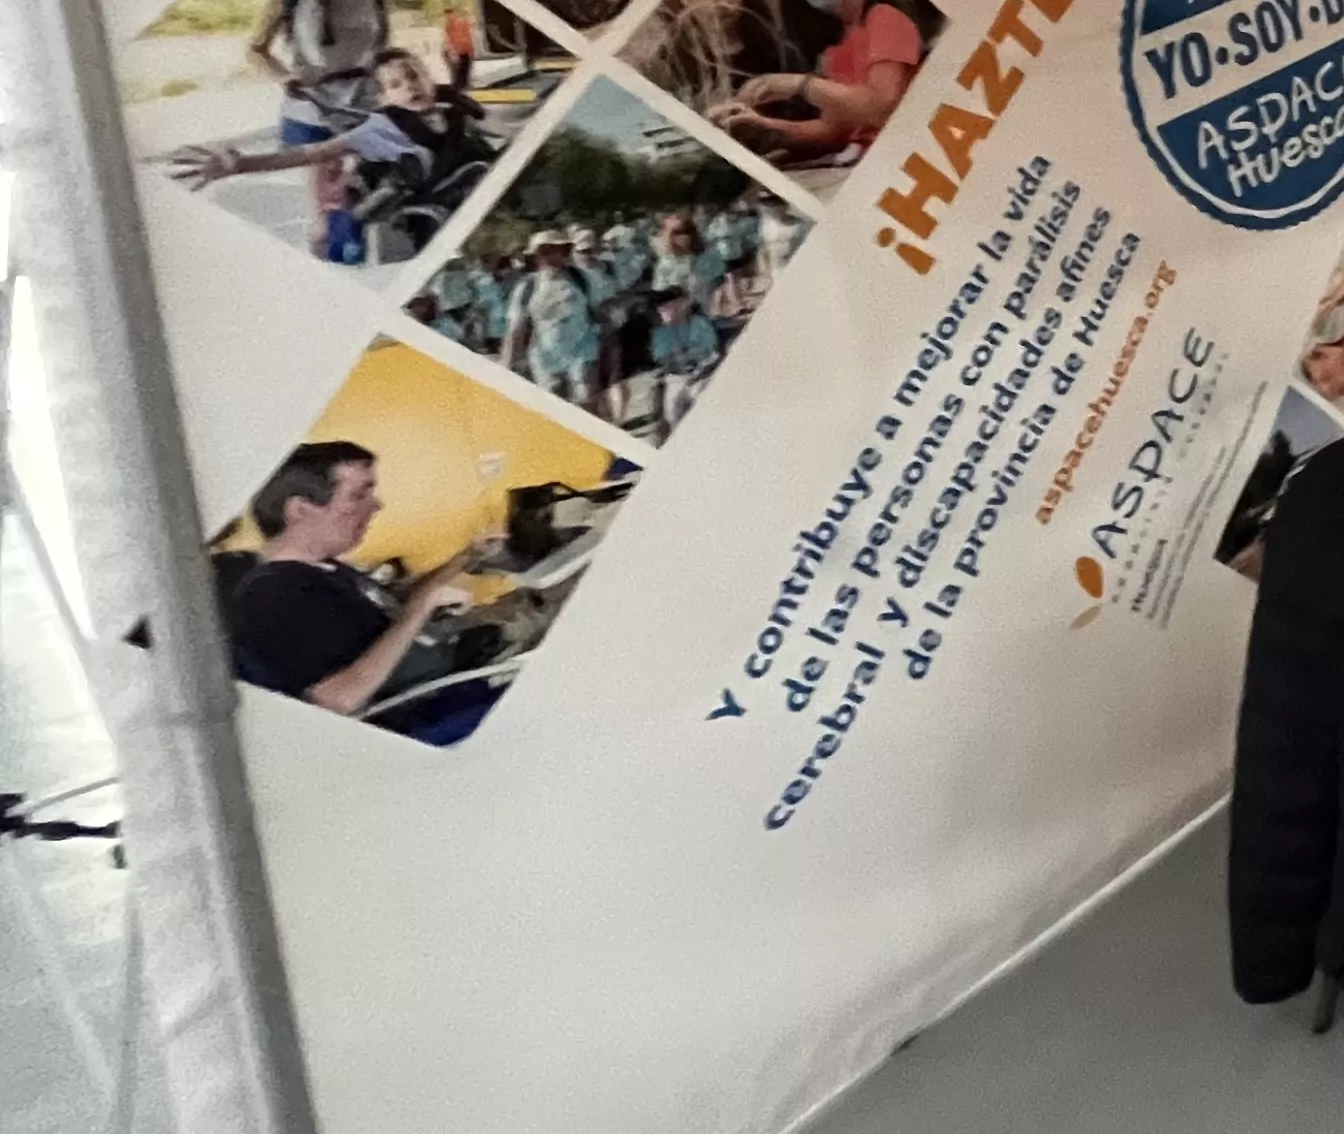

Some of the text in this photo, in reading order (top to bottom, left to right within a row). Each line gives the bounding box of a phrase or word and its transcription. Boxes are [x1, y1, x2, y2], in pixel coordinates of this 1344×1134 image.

[705, 155, 1052, 721] Y contribuye a mejorar la vida
[764, 206, 1114, 832] cerebral y discapacidades afines
[782, 180, 1082, 714] de las personas con parálisis
[906, 230, 1144, 681] de la provincia de Huesca
[1032, 259, 1178, 526] aspacehuesca.org
[1091, 327, 1215, 559] ASPACE
